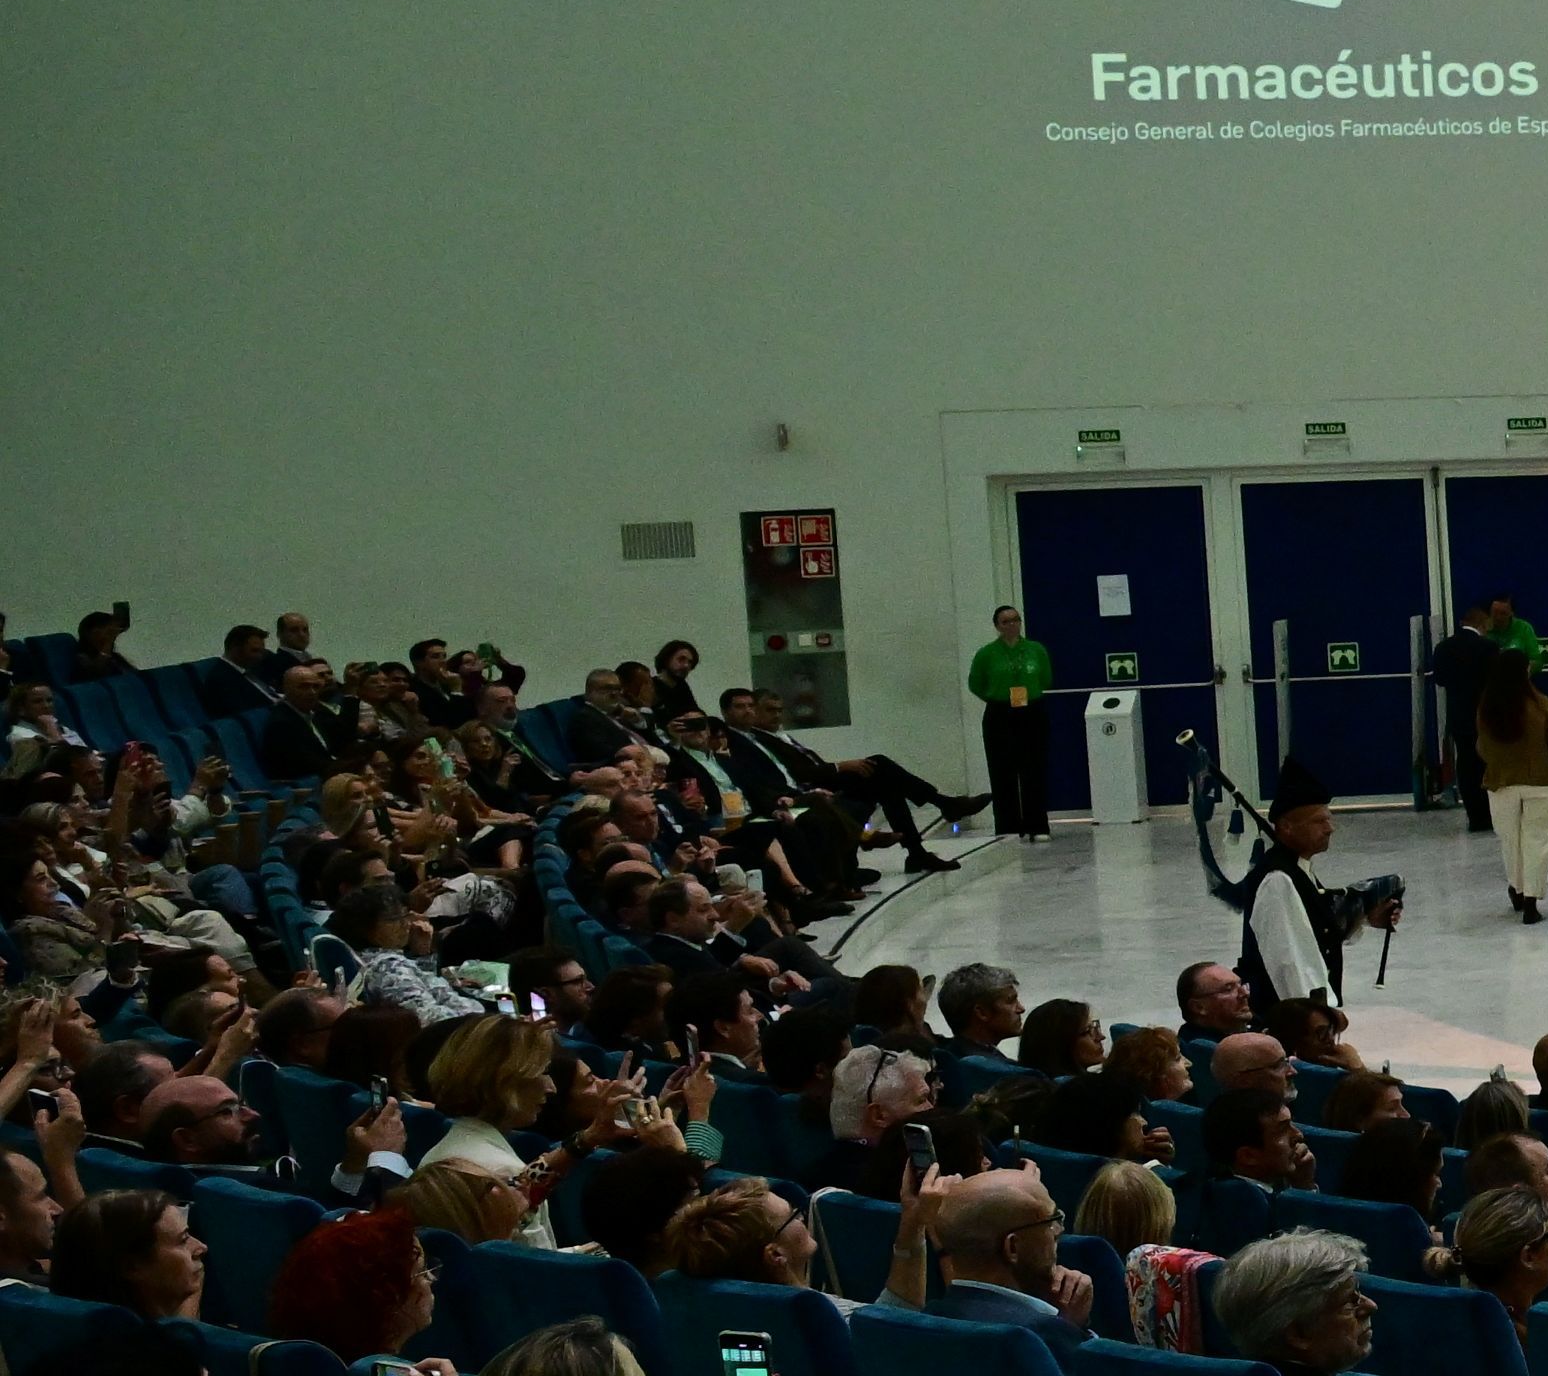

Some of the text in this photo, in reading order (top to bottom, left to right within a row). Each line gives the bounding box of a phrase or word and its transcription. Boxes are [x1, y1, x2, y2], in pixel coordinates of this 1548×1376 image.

[1091, 50, 1539, 101] Farmacéuticos
[1045, 123, 1129, 145] Consejo
[1135, 120, 1214, 141] General
[1219, 120, 1244, 139] de
[1249, 119, 1335, 142] Colegios
[1341, 117, 1483, 138] Farmacéuticos
[1488, 116, 1513, 135] de
[1081, 432, 1118, 442] SALIDA
[1307, 424, 1343, 434] SALIDA
